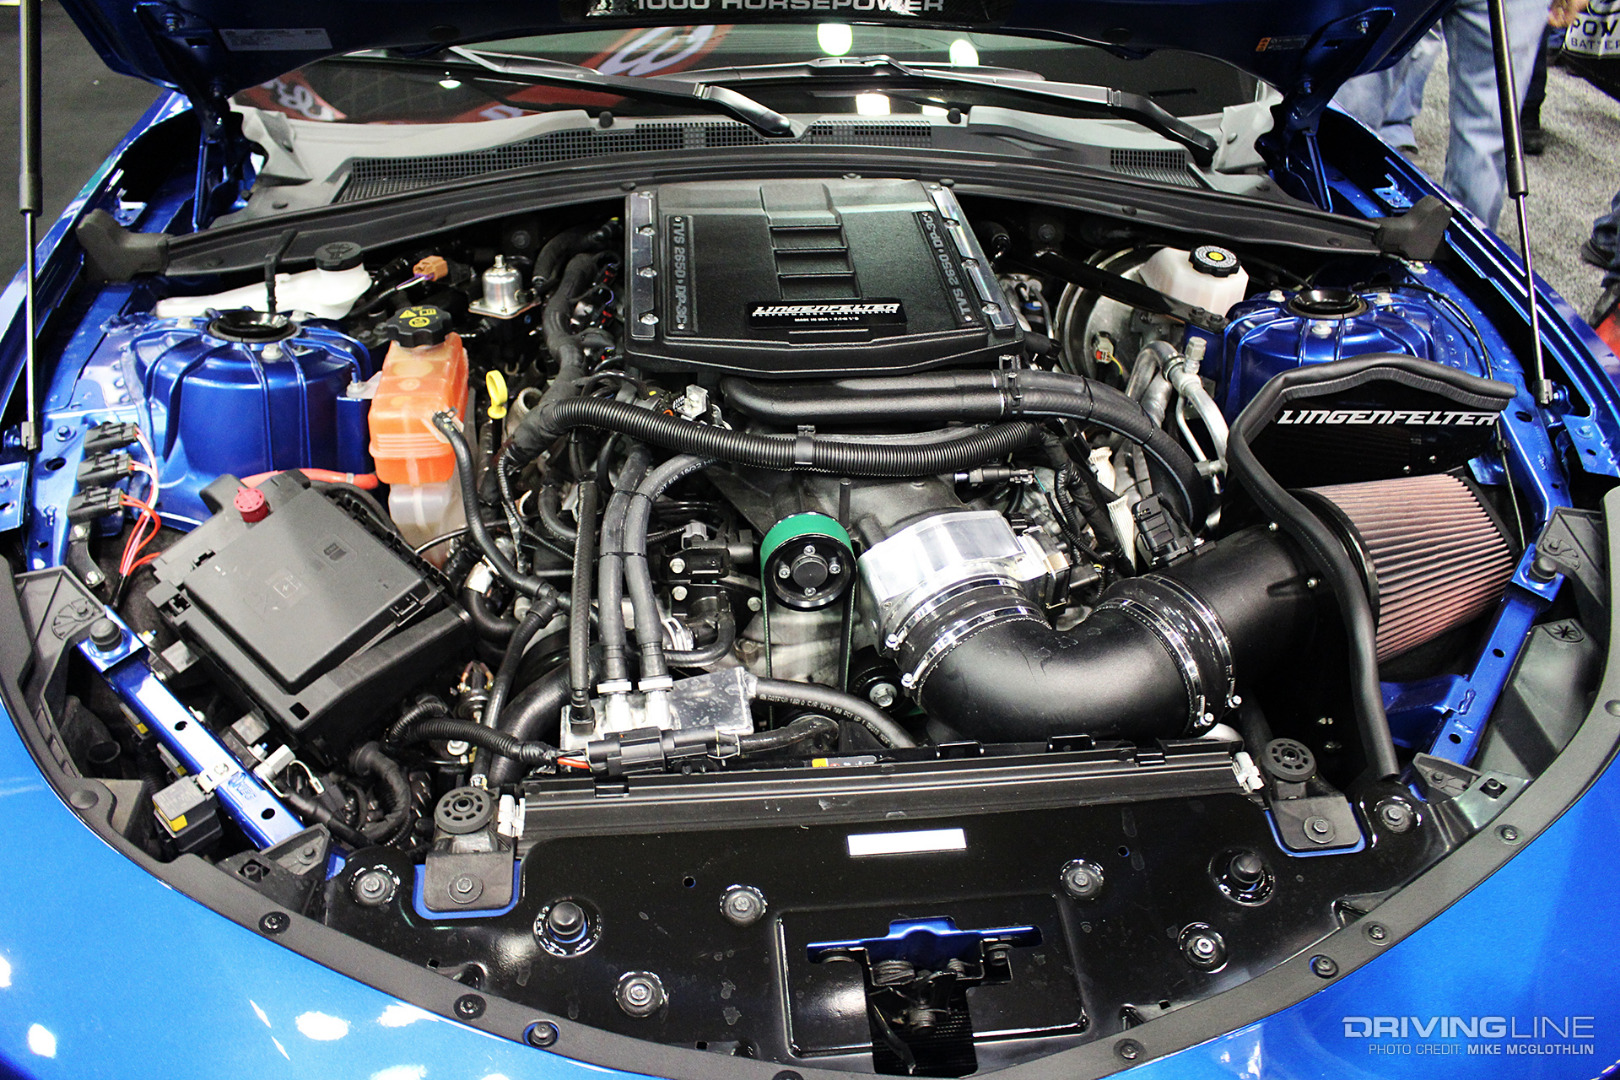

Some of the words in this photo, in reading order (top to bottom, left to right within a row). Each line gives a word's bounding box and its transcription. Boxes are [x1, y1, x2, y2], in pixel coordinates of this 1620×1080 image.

[638, 0, 710, 10] 1000
[721, 0, 944, 12] HORSEPOWER
[672, 221, 685, 245] TVS
[674, 246, 687, 278] 2650
[938, 253, 960, 286] 2650
[752, 303, 901, 314] LINGENFELTER
[952, 287, 972, 316] TVS
[1277, 410, 1500, 426] LINGENFELTER
